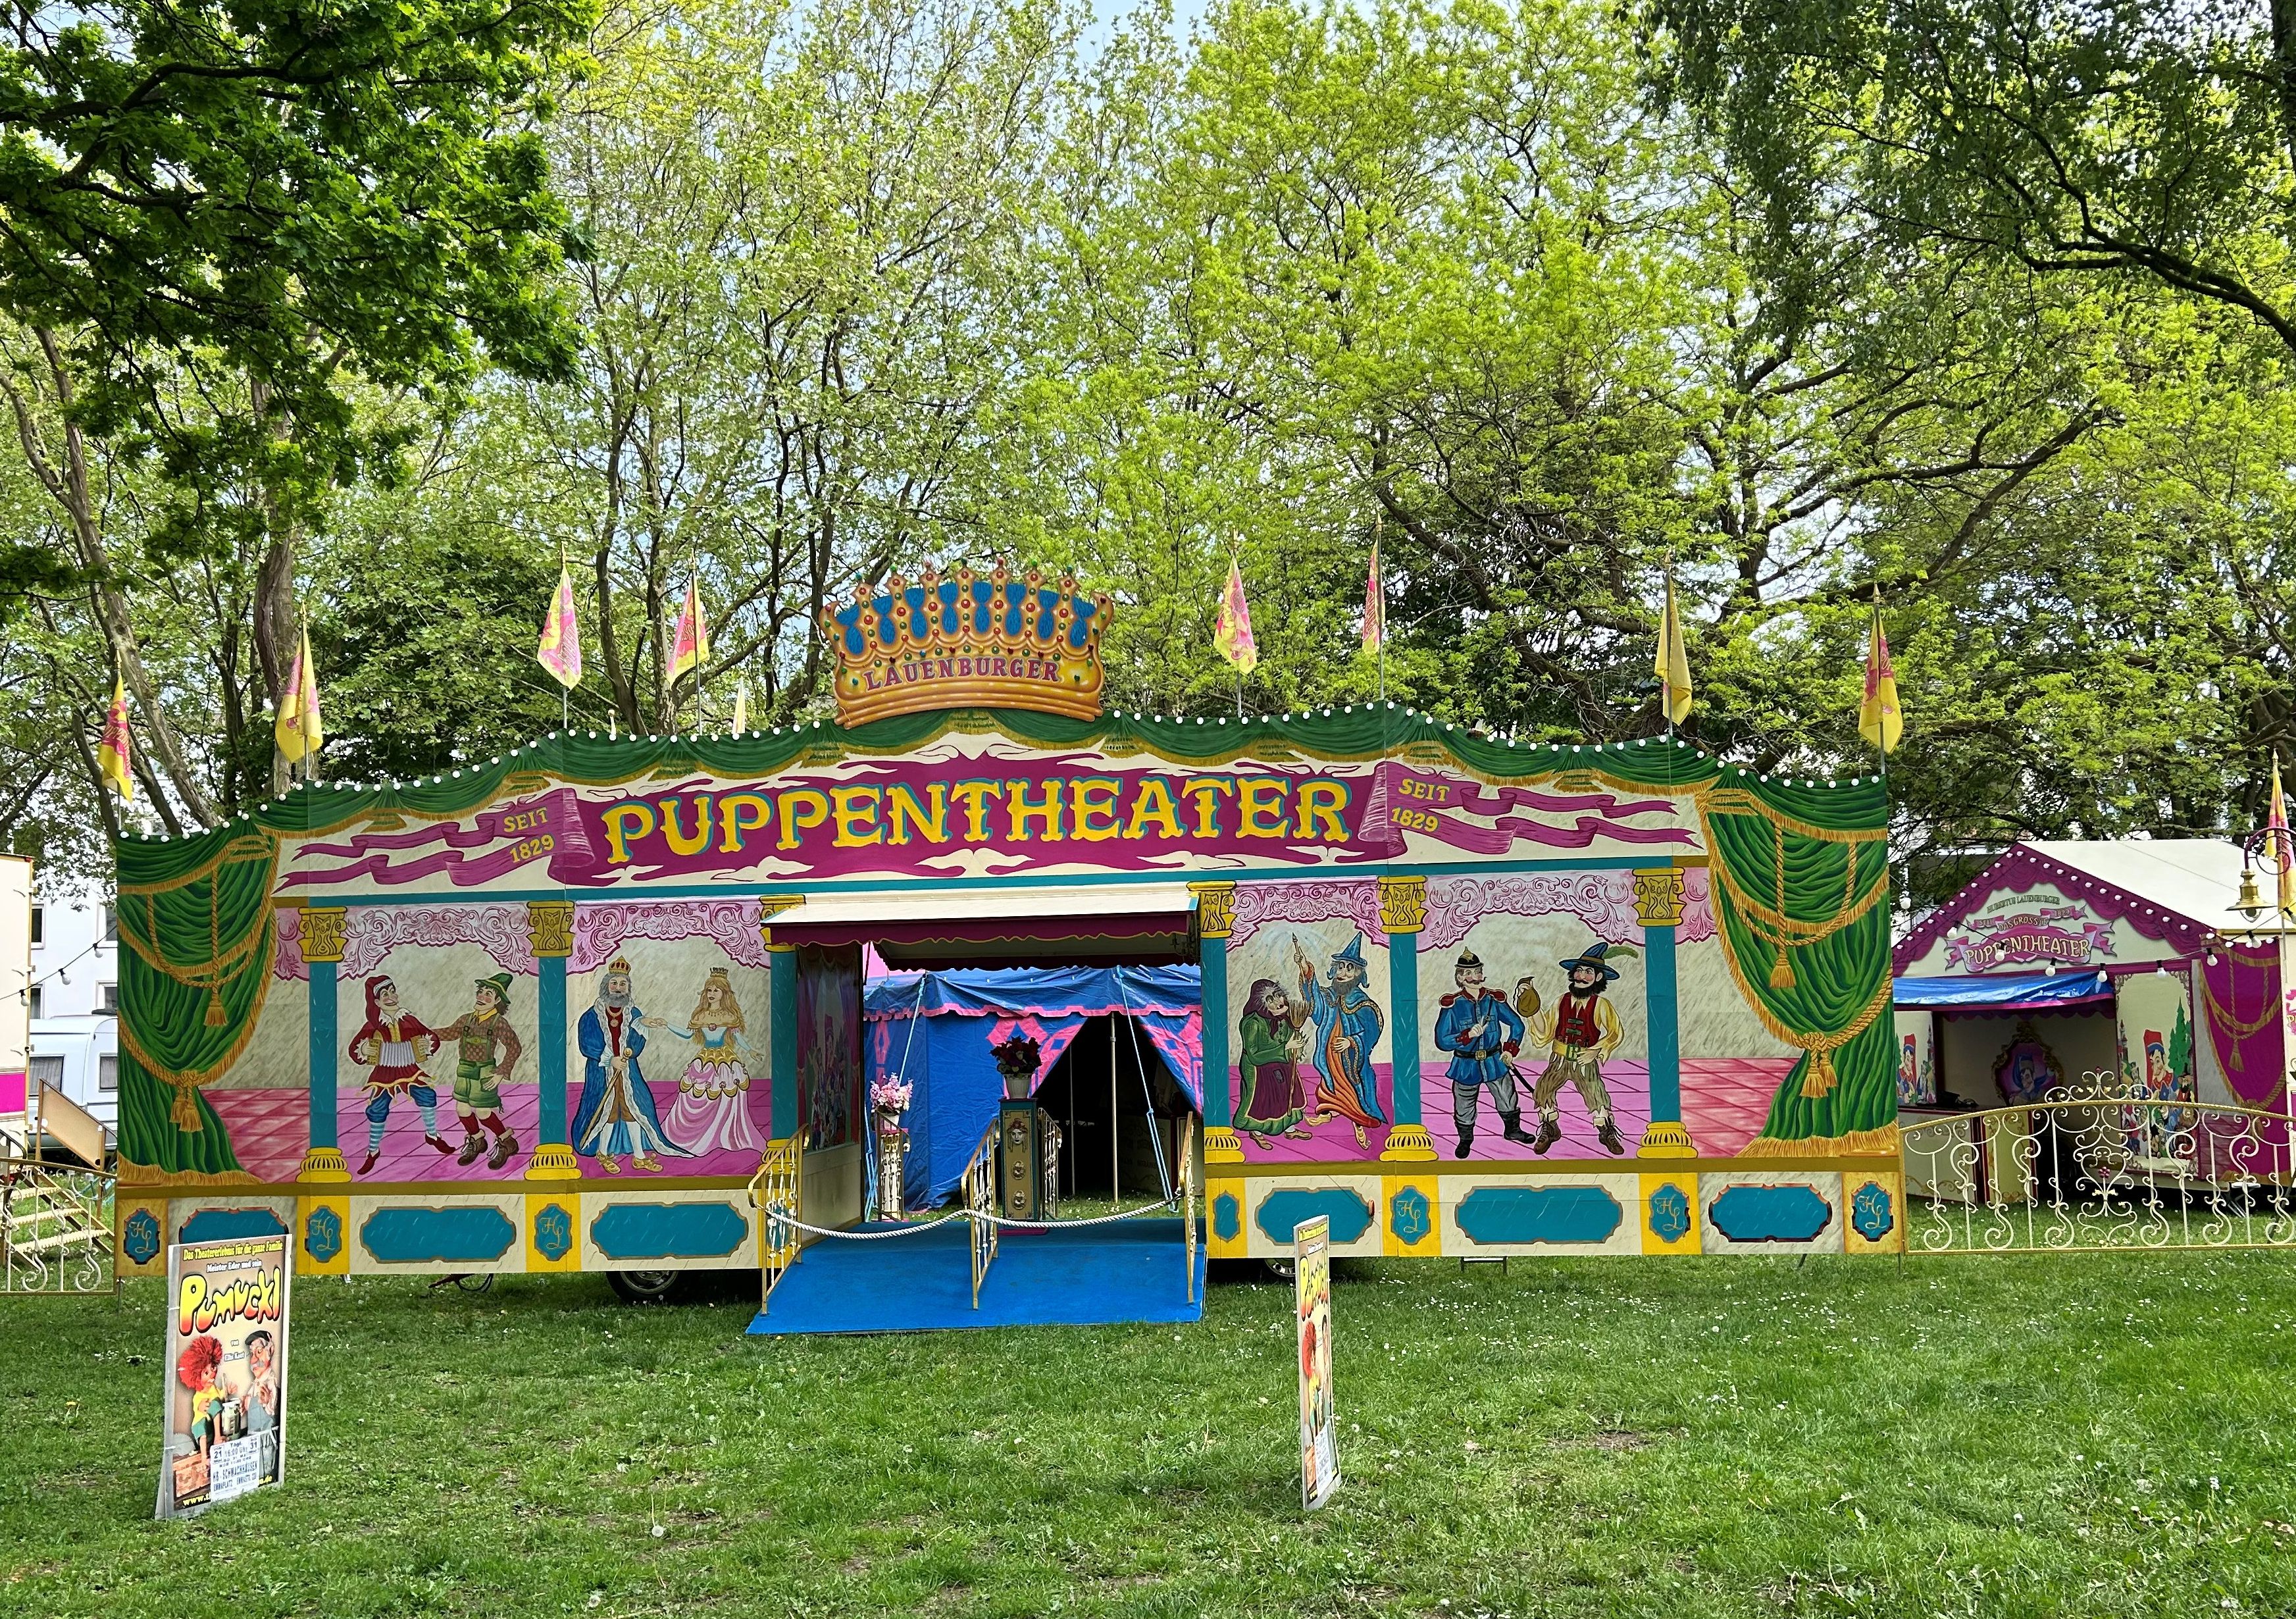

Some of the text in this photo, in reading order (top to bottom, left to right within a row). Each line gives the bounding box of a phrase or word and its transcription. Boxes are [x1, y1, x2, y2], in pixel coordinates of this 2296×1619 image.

[863, 655, 1062, 692] LAUENBURGER
[1398, 778, 1450, 802] SEIT
[503, 806, 548, 833] SEIT
[600, 776, 1354, 863] PUPPENTHEATER
[1390, 807, 1439, 833] 1829
[509, 834, 555, 863] 1829
[1964, 935, 2091, 965] PUPPENTHEATER
[183, 1248, 194, 1261] Das
[194, 1245, 235, 1260] Theatererlebnis
[235, 1243, 243, 1256] für
[251, 1243, 265, 1256] ganze
[265, 1240, 283, 1252] Familie
[206, 1262, 227, 1273] Meister
[228, 1261, 241, 1271] Eder
[214, 1451, 222, 1459] 21
